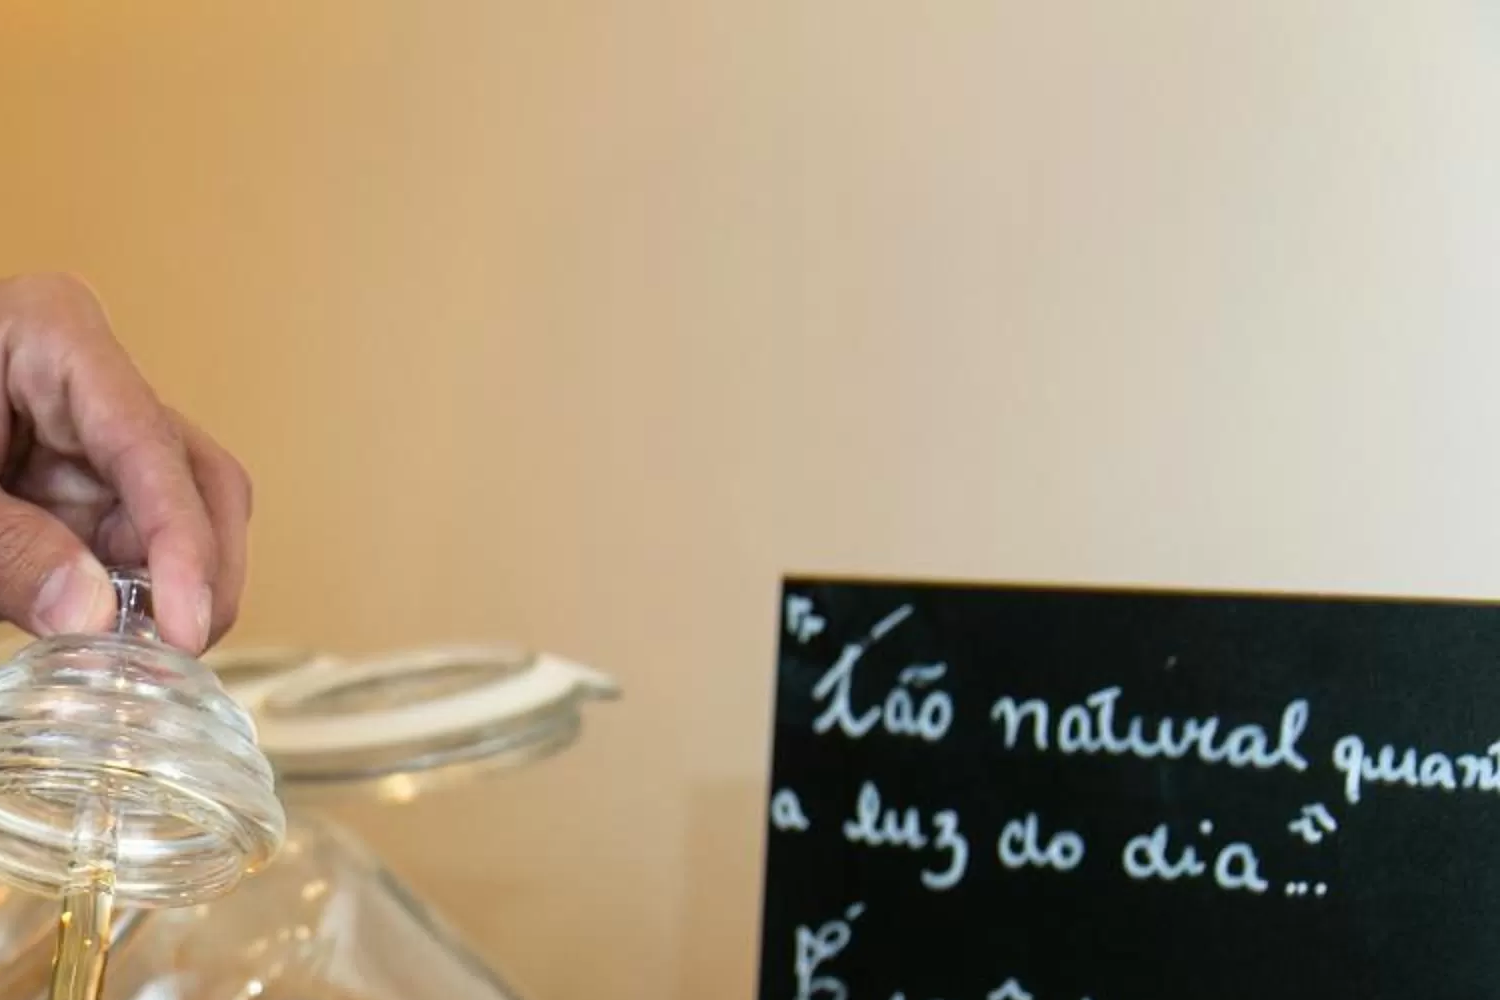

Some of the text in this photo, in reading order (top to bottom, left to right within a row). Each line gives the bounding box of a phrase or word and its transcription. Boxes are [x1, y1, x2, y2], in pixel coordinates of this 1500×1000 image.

[990, 685, 1310, 772] natural
[771, 789, 808, 829] a
[844, 780, 969, 890] luz
[998, 814, 1085, 871] do
